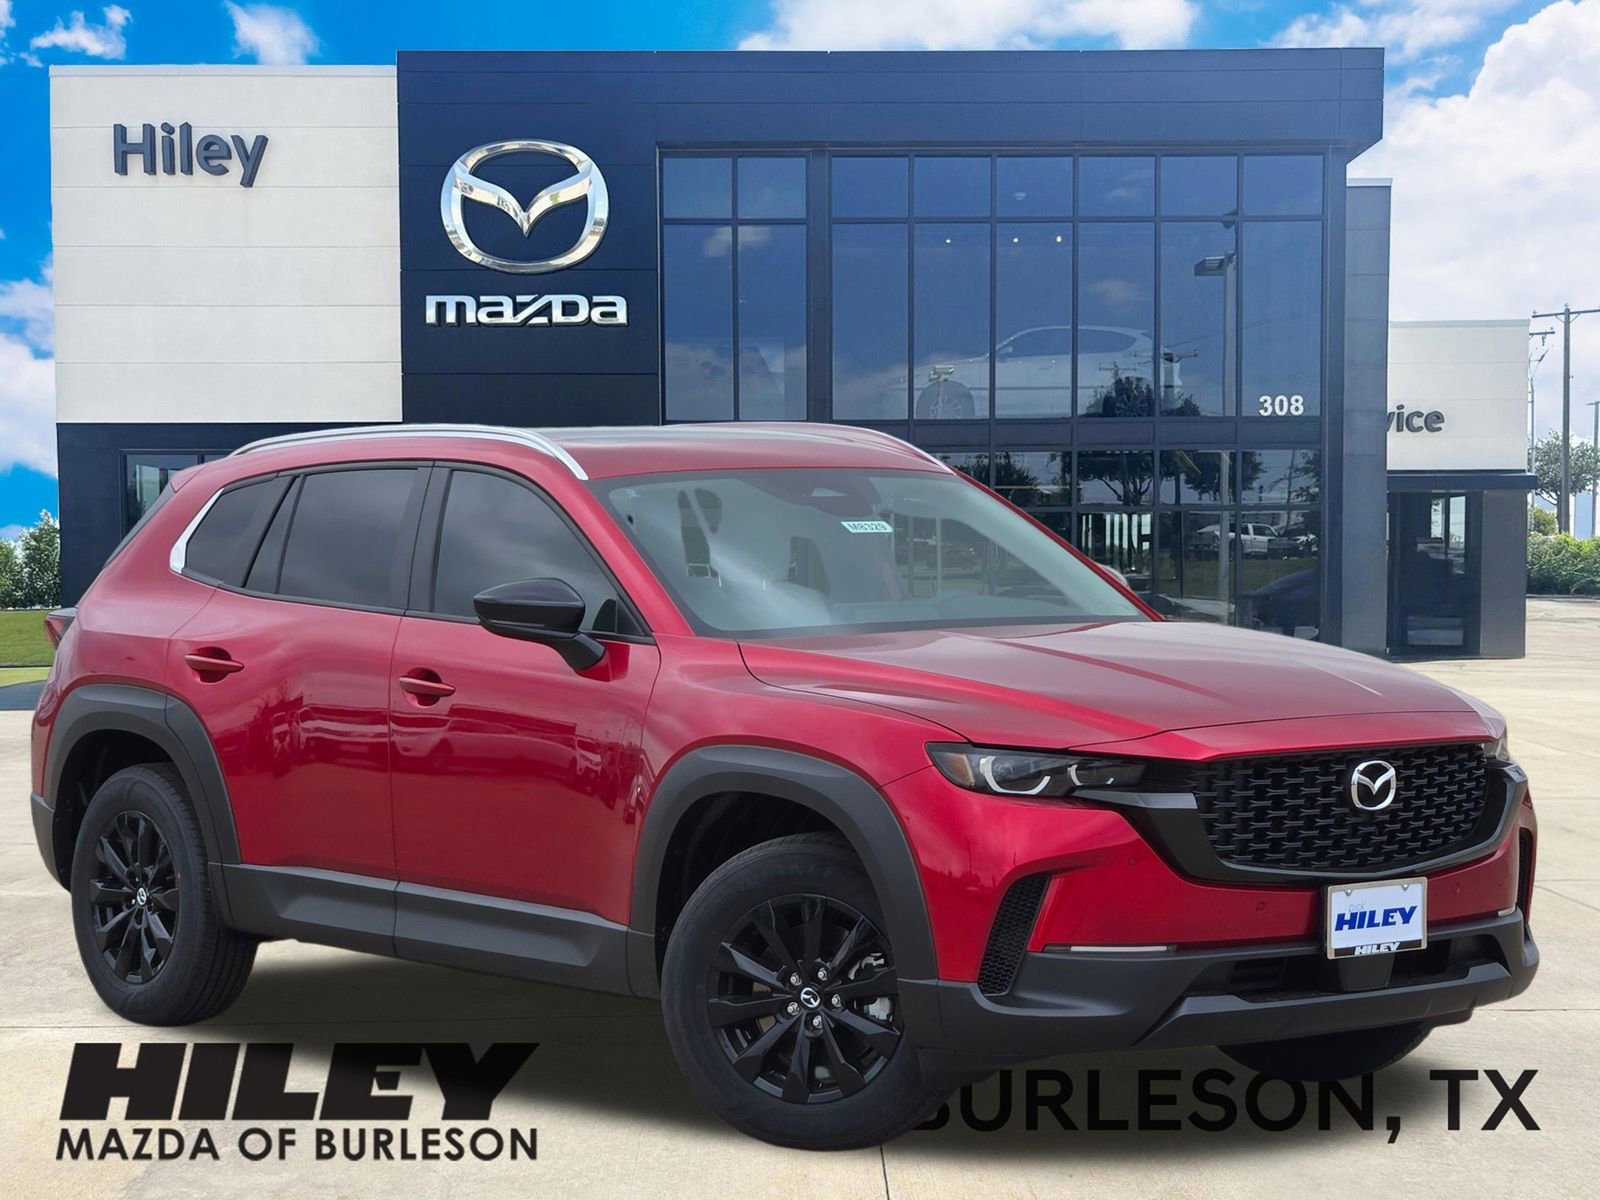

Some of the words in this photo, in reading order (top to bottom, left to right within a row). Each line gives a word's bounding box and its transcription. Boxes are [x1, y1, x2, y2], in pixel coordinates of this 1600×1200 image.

[113, 122, 269, 188] Hiley
[1258, 394, 1305, 416] 308
[1334, 905, 1418, 931] HILEY
[1354, 941, 1400, 956] HILEY
